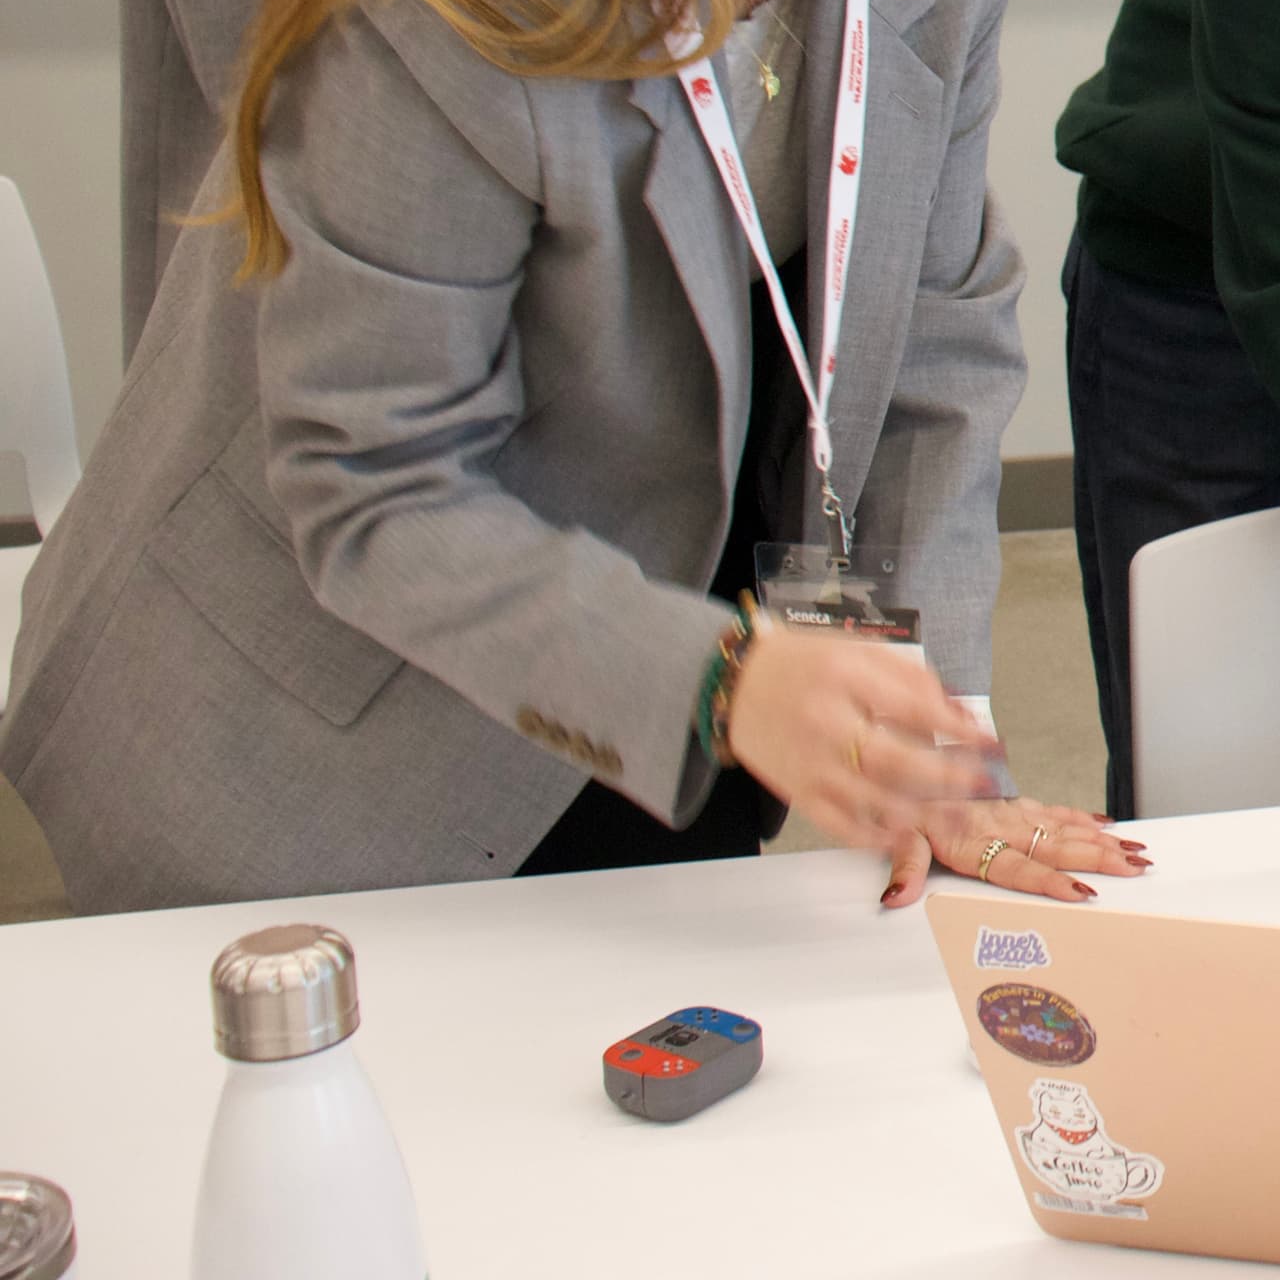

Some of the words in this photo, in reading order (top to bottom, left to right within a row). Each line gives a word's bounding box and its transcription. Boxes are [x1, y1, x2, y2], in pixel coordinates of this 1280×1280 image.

[785, 607, 832, 625] Seneca
[981, 929, 1041, 950] inner
[977, 946, 1048, 967] peace
